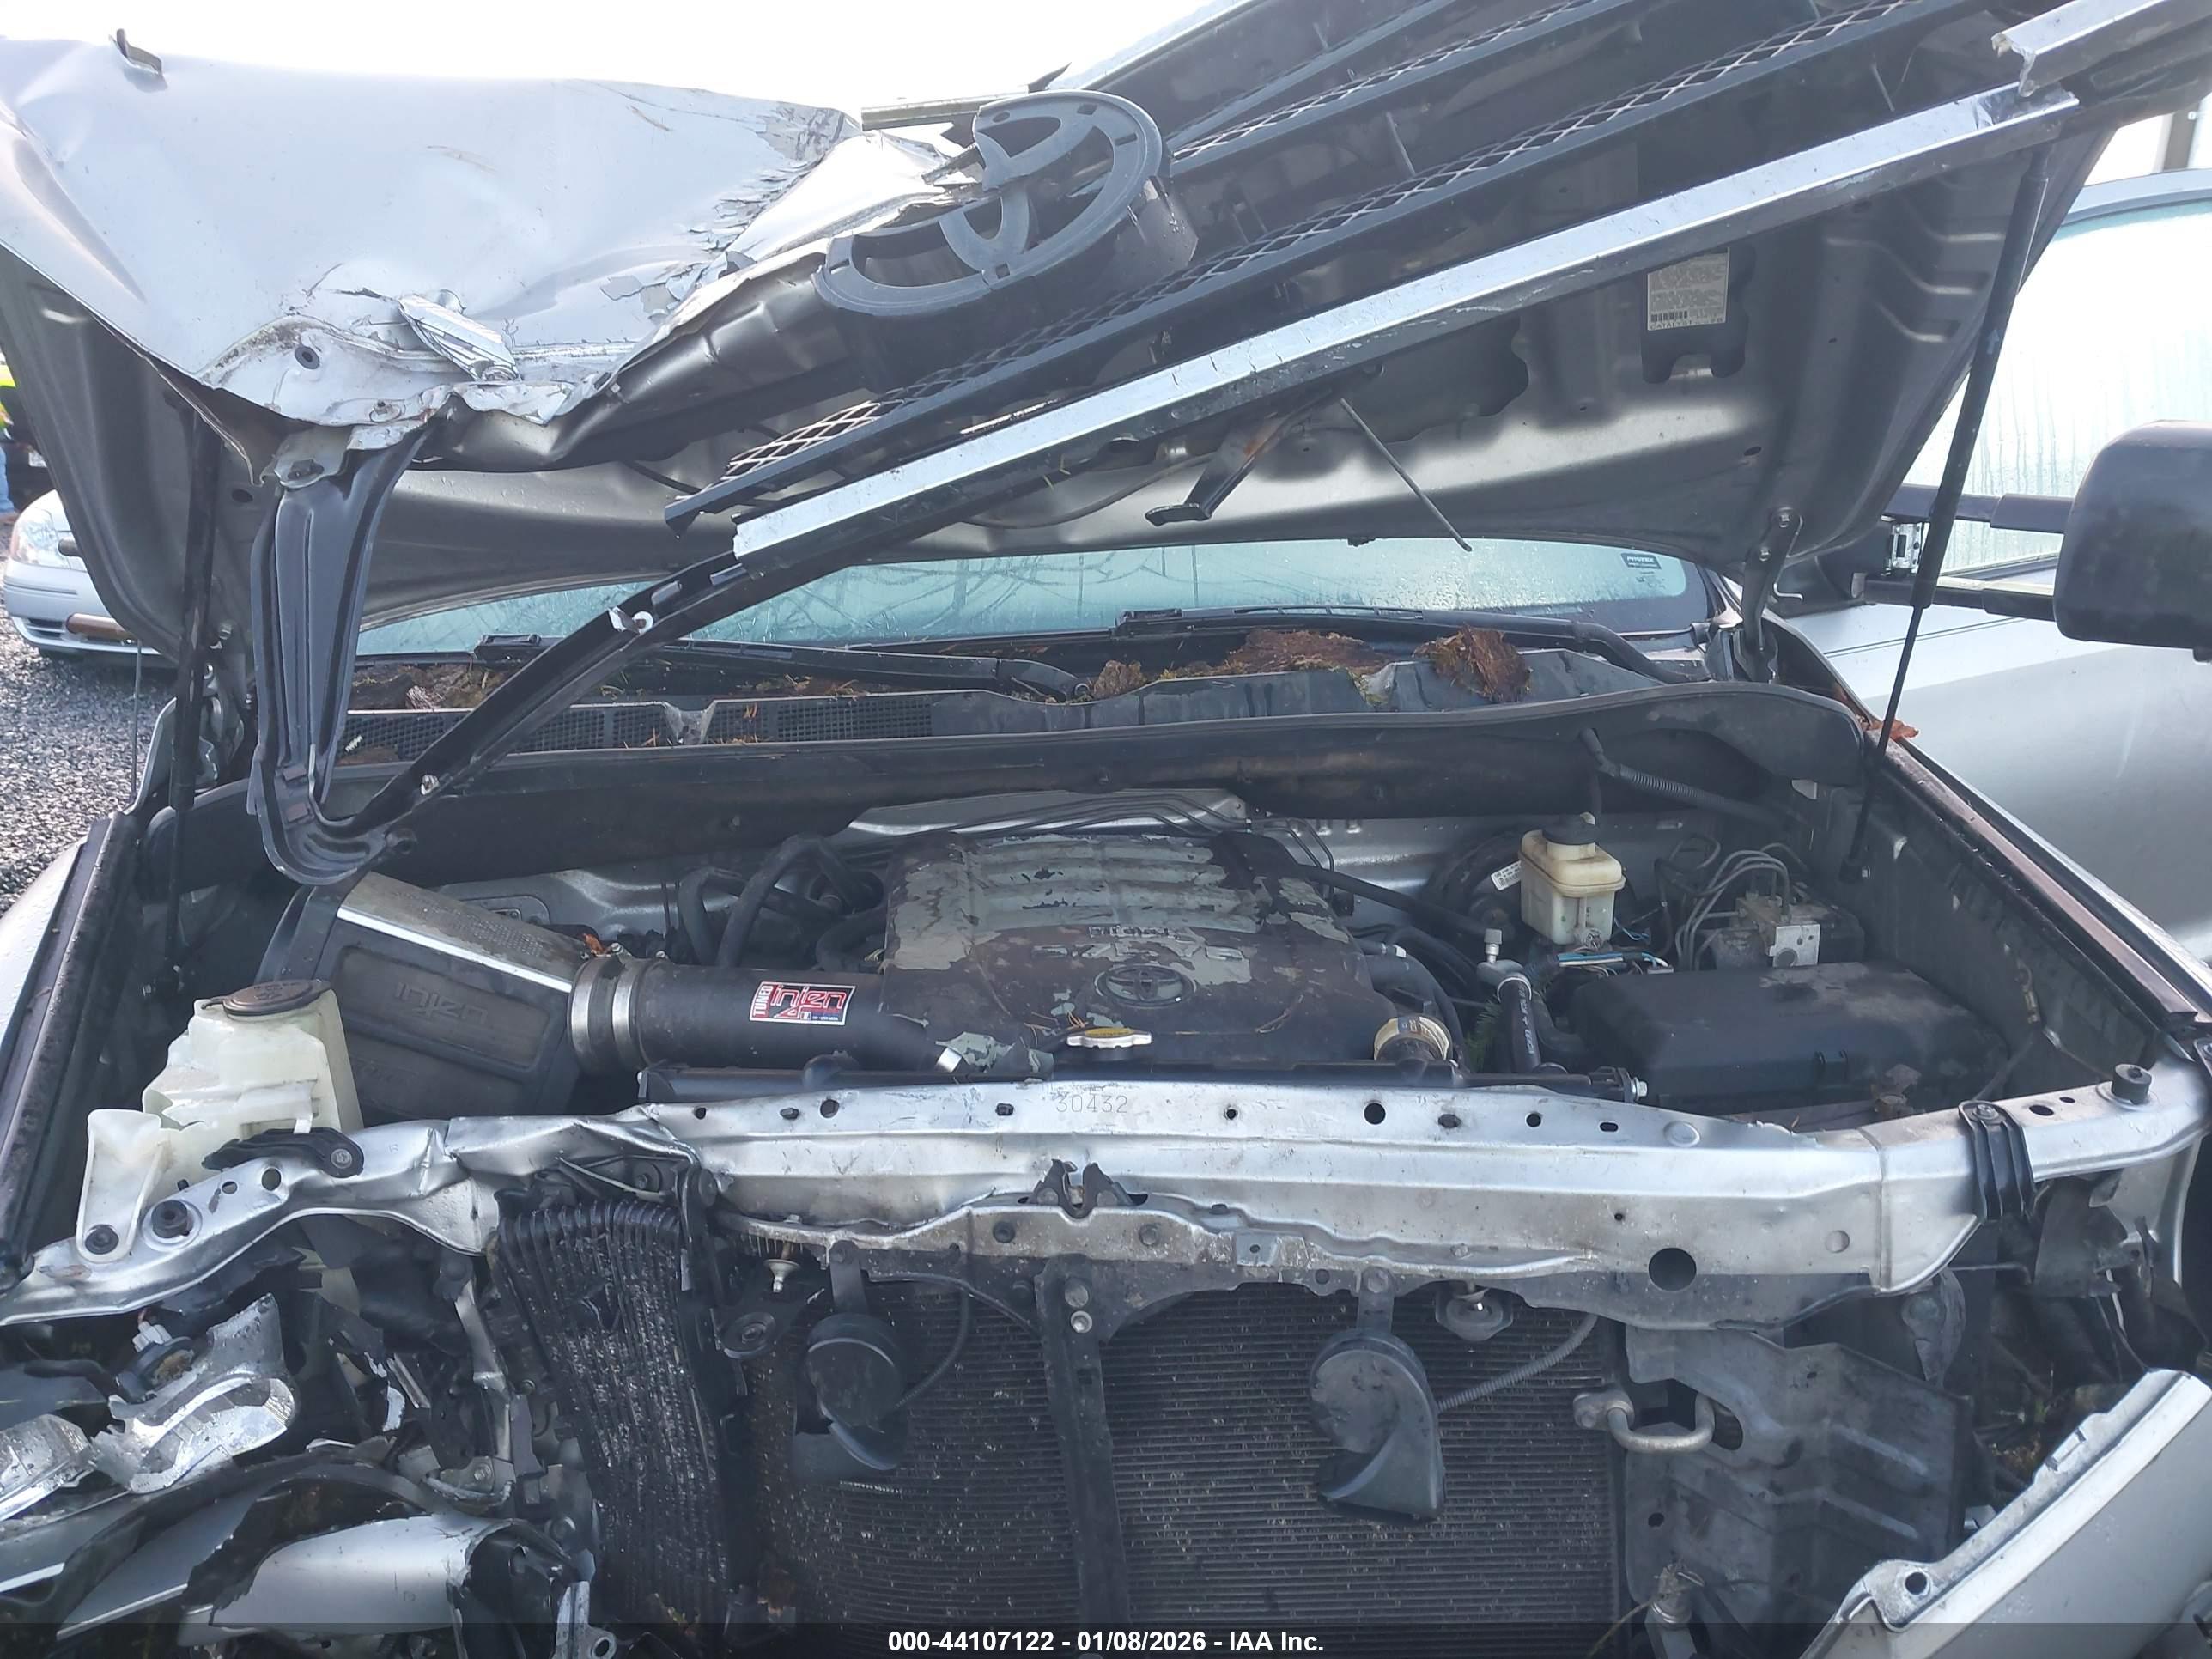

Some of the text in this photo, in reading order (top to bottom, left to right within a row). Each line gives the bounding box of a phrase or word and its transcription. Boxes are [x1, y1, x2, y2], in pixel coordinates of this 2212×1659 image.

[753, 985, 774, 1017] TUNED
[770, 984, 848, 1019] injen
[1056, 1093, 1127, 1114] 30432
